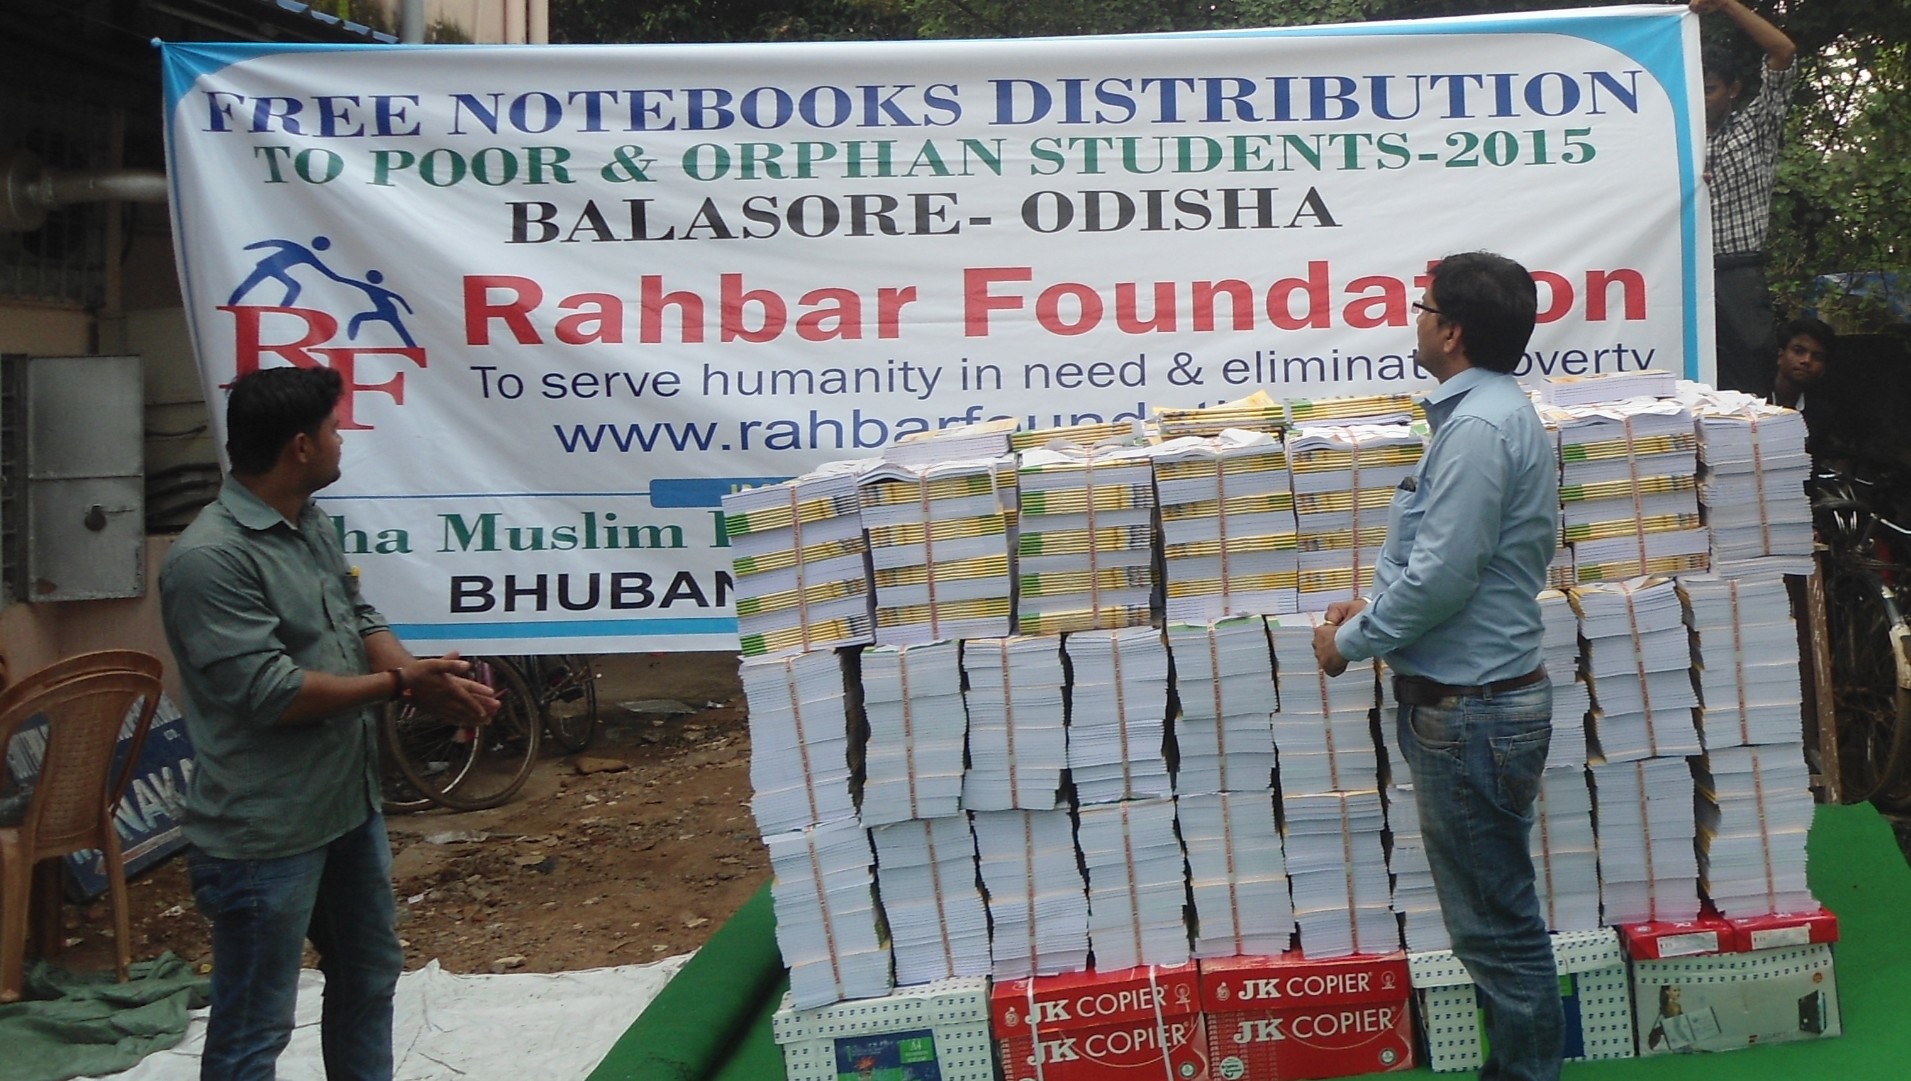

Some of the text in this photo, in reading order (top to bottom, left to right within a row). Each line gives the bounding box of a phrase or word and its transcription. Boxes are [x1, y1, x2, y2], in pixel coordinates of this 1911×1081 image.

[201, 70, 1643, 138] FREE NOTEBOOKS DISTRIBUTION
[254, 126, 1597, 187] TO POOR & ORPHAN STUDENTS-2015
[504, 186, 1344, 244] BALASORE- ODISHA
[462, 260, 1647, 346] Rahbar Foundaon
[470, 342, 1656, 401] To serve humanity in need & eliminat overty
[436, 510, 688, 553] Muslim
[1024, 985, 1167, 1025] JK COPIER
[1238, 972, 1371, 1001] JK COPIER
[1026, 1037, 1080, 1066] JK
[1084, 1022, 1188, 1058] COPIER
[1232, 1006, 1394, 1045] JK COPIER
